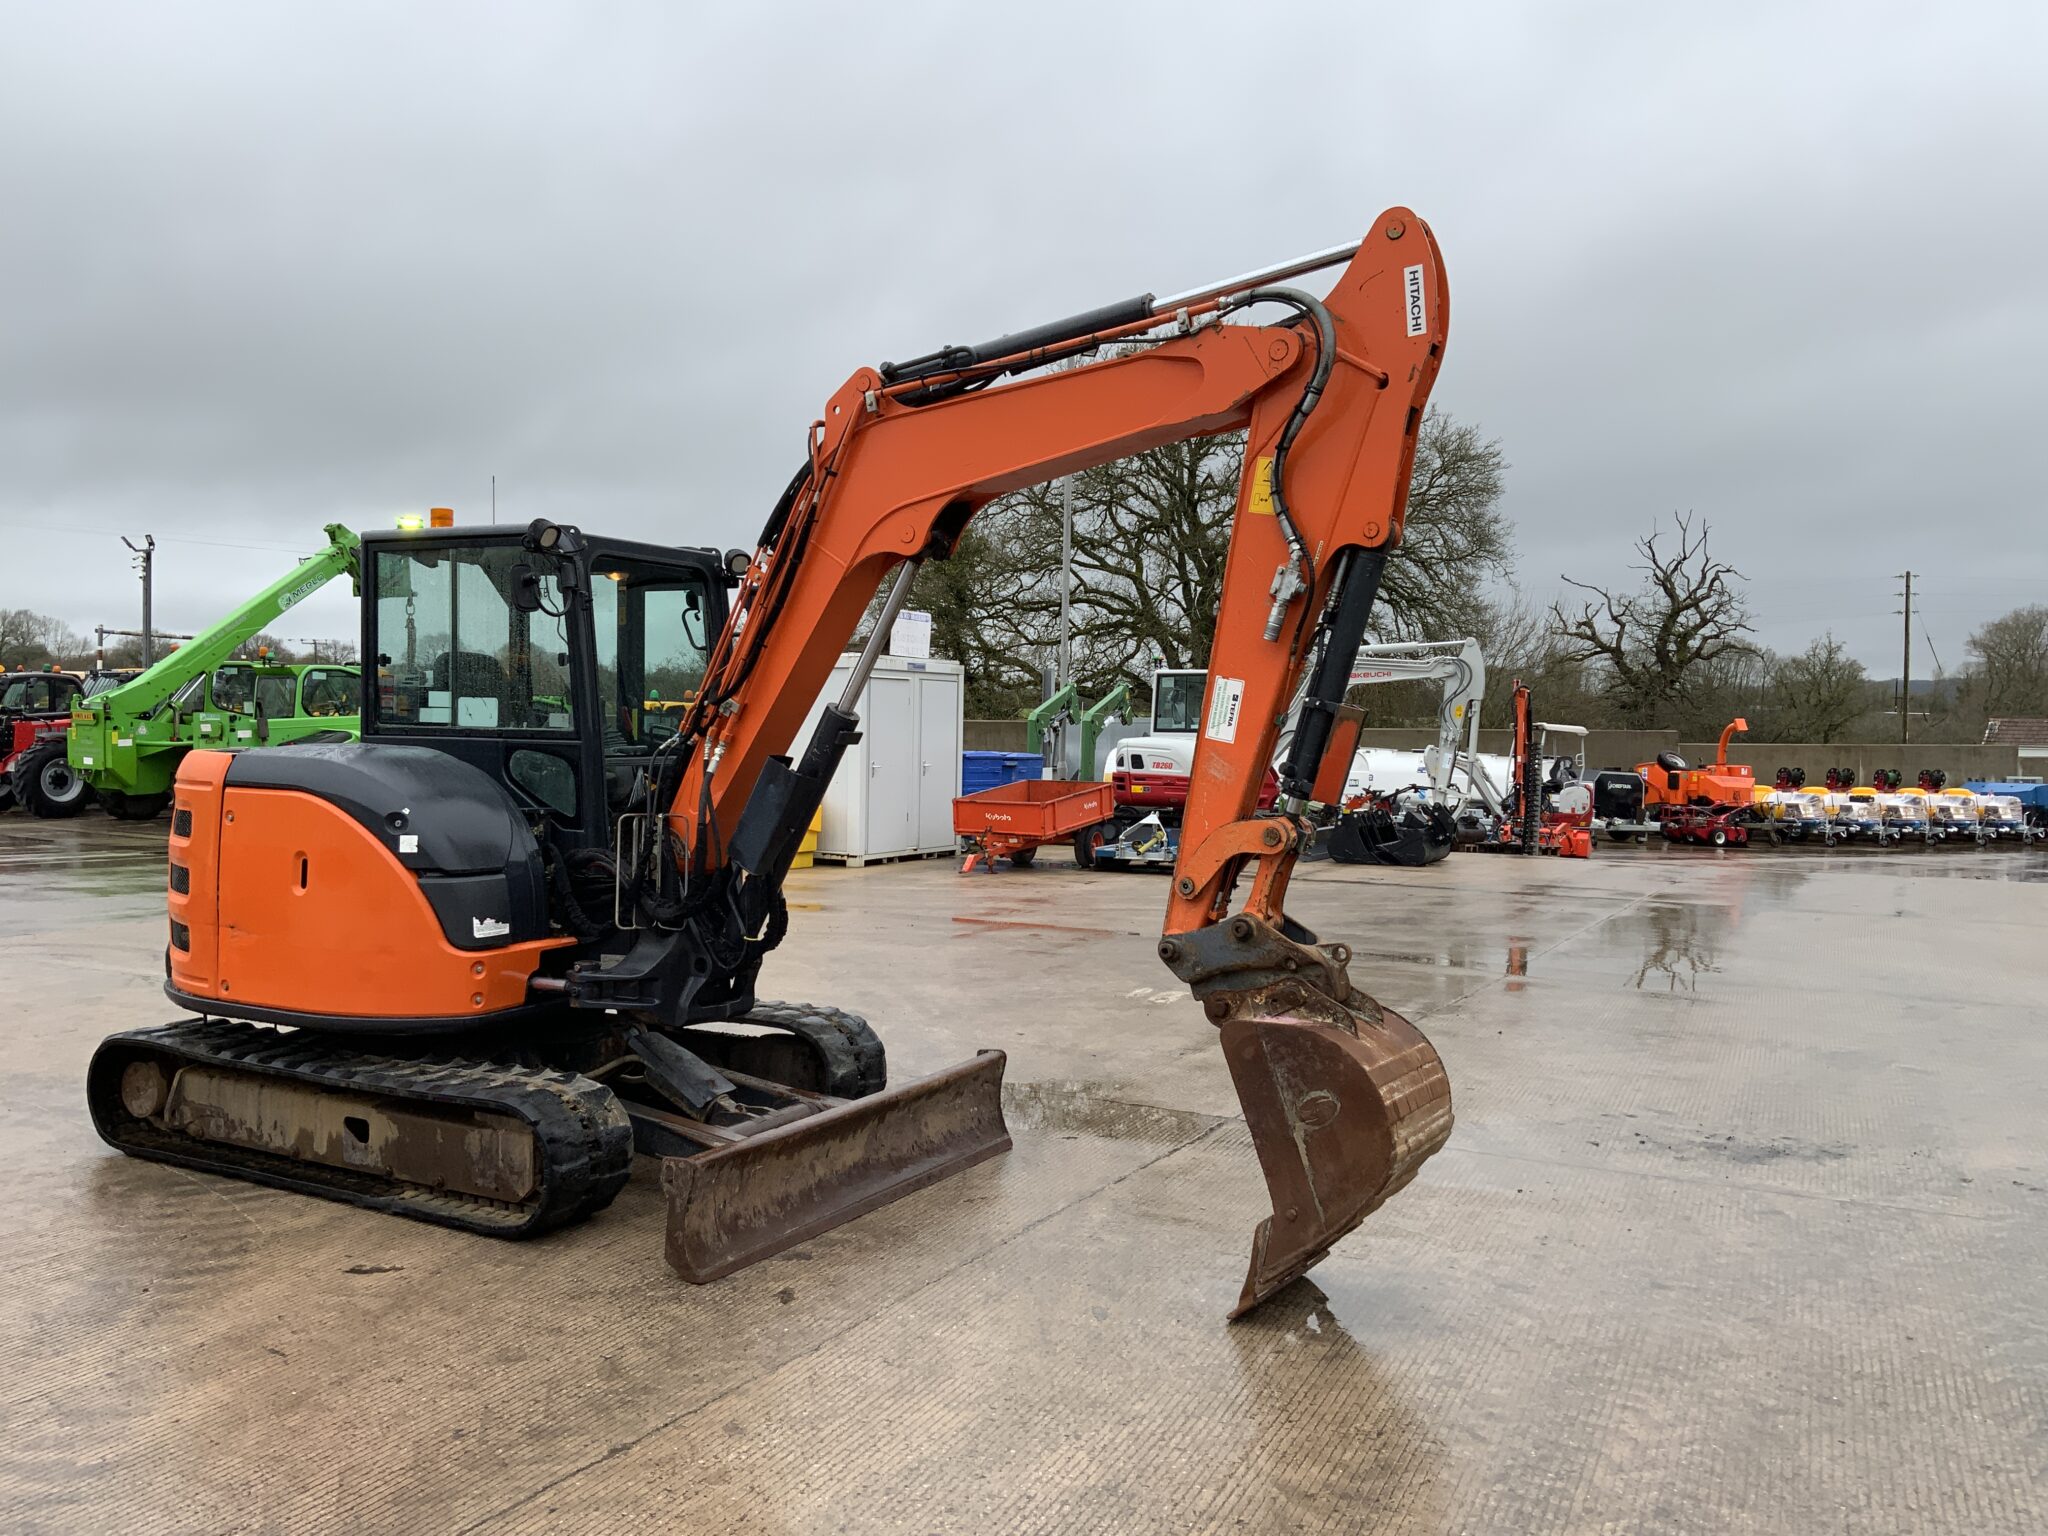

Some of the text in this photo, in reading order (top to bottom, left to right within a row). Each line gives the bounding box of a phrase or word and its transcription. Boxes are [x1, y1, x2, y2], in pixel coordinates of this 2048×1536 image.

[1409, 270, 1422, 332] HITACHI
[292, 573, 325, 598] MERLO
[1227, 703, 1236, 727] TEFRA
[985, 812, 1011, 821] Kubota
